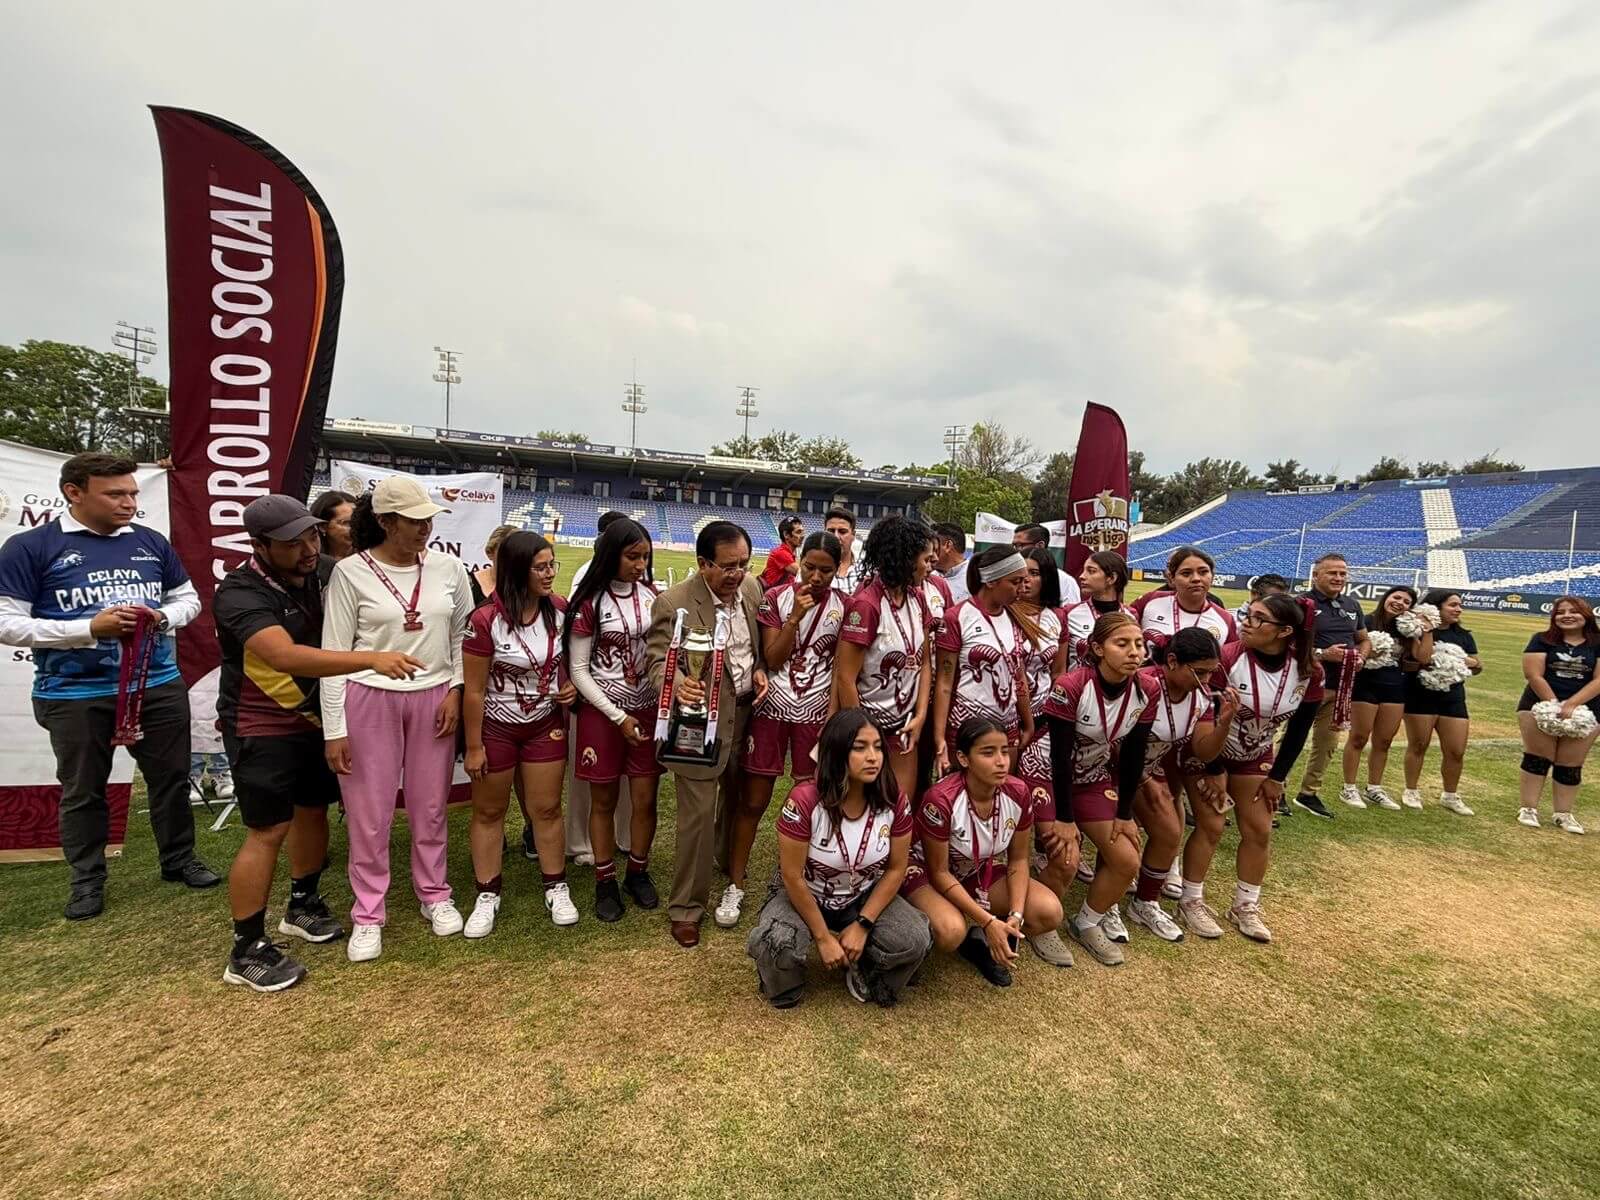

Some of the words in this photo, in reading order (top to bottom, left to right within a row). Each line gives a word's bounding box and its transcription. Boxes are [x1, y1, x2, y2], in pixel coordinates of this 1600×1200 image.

[209, 182, 273, 344] SOCIAL
[207, 354, 271, 592] SARROLLO
[461, 489, 495, 501] Celaya
[1070, 523, 1083, 537] LA
[87, 568, 141, 584] CELAYA
[1343, 583, 1392, 600] KIP
[1498, 599, 1530, 610] Corona
